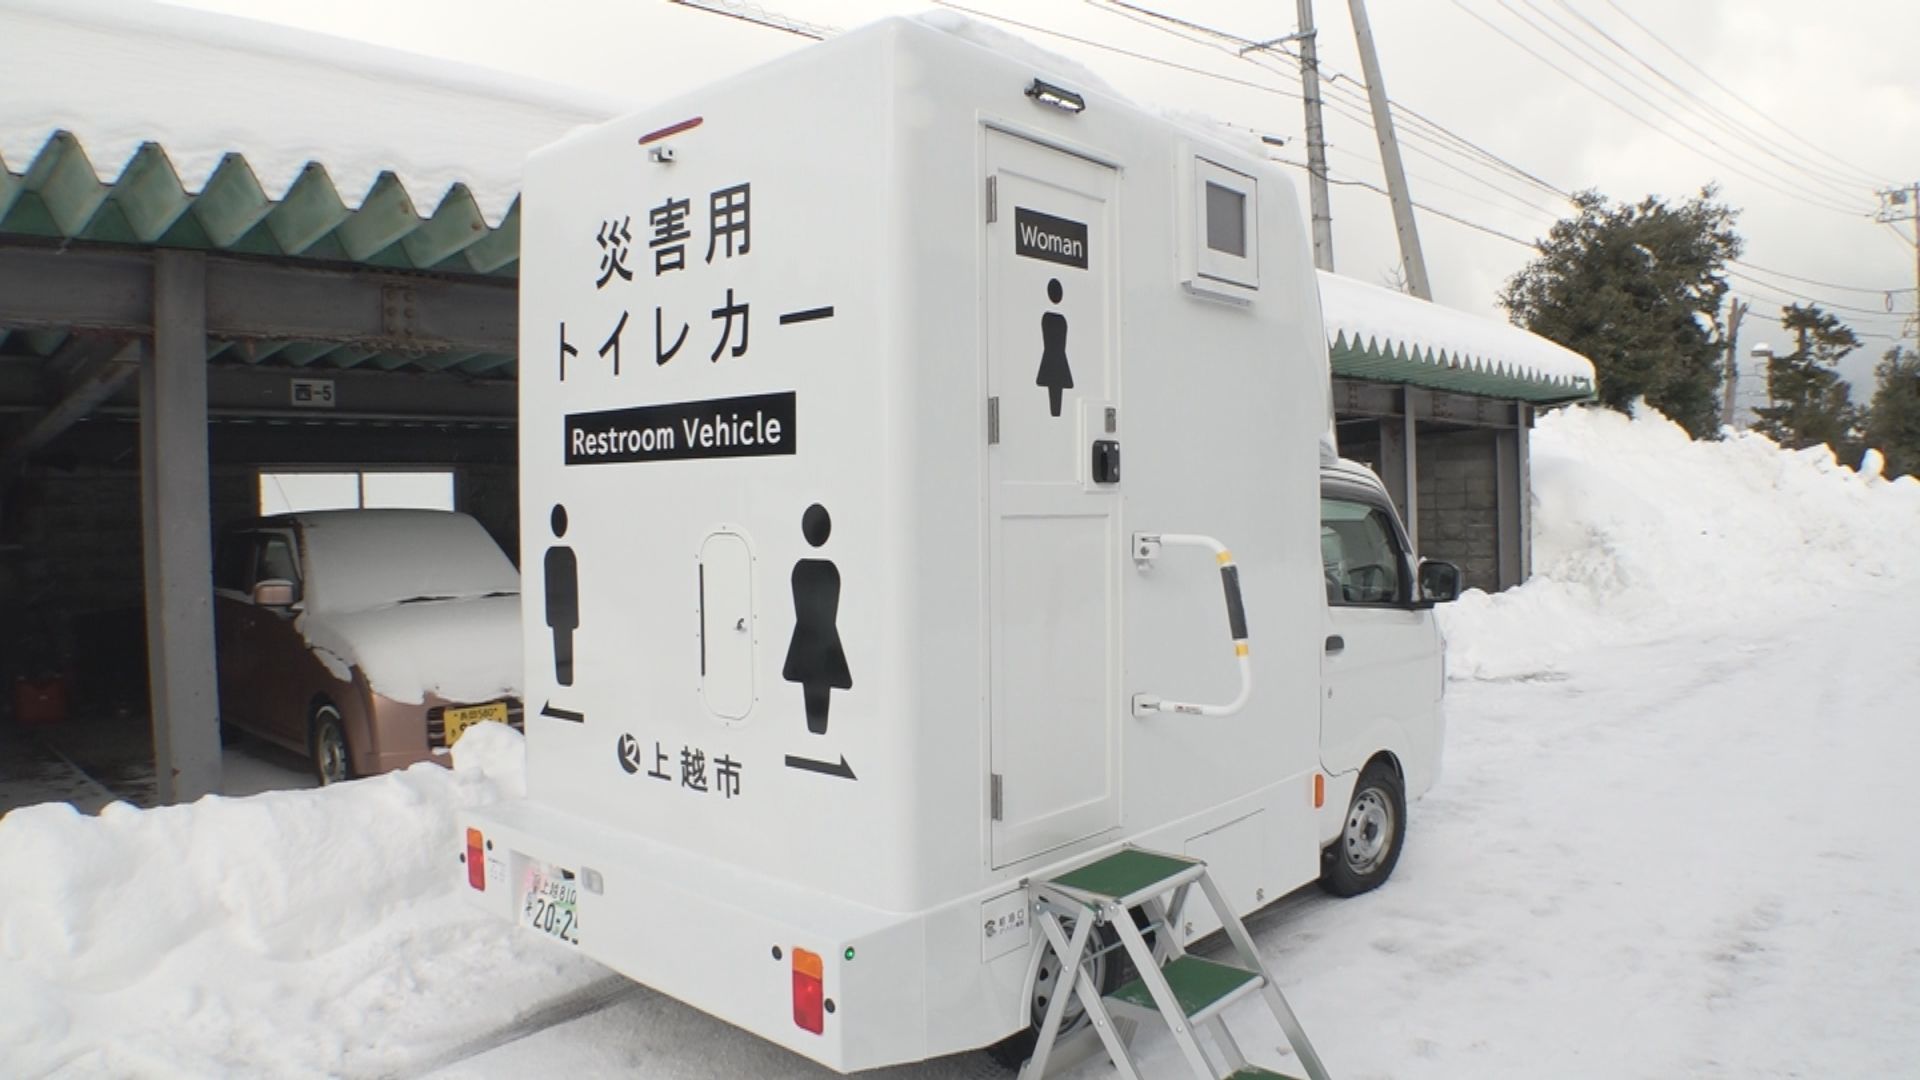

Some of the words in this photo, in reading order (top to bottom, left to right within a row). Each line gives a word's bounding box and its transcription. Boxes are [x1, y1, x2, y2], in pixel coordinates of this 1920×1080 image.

[596, 182, 750, 290] 災害用
[1020, 222, 1083, 258] Woman
[559, 288, 834, 381] トイレカー
[572, 426, 675, 456] Restroom
[682, 411, 781, 449] Vehicle
[647, 741, 742, 799] 上越市
